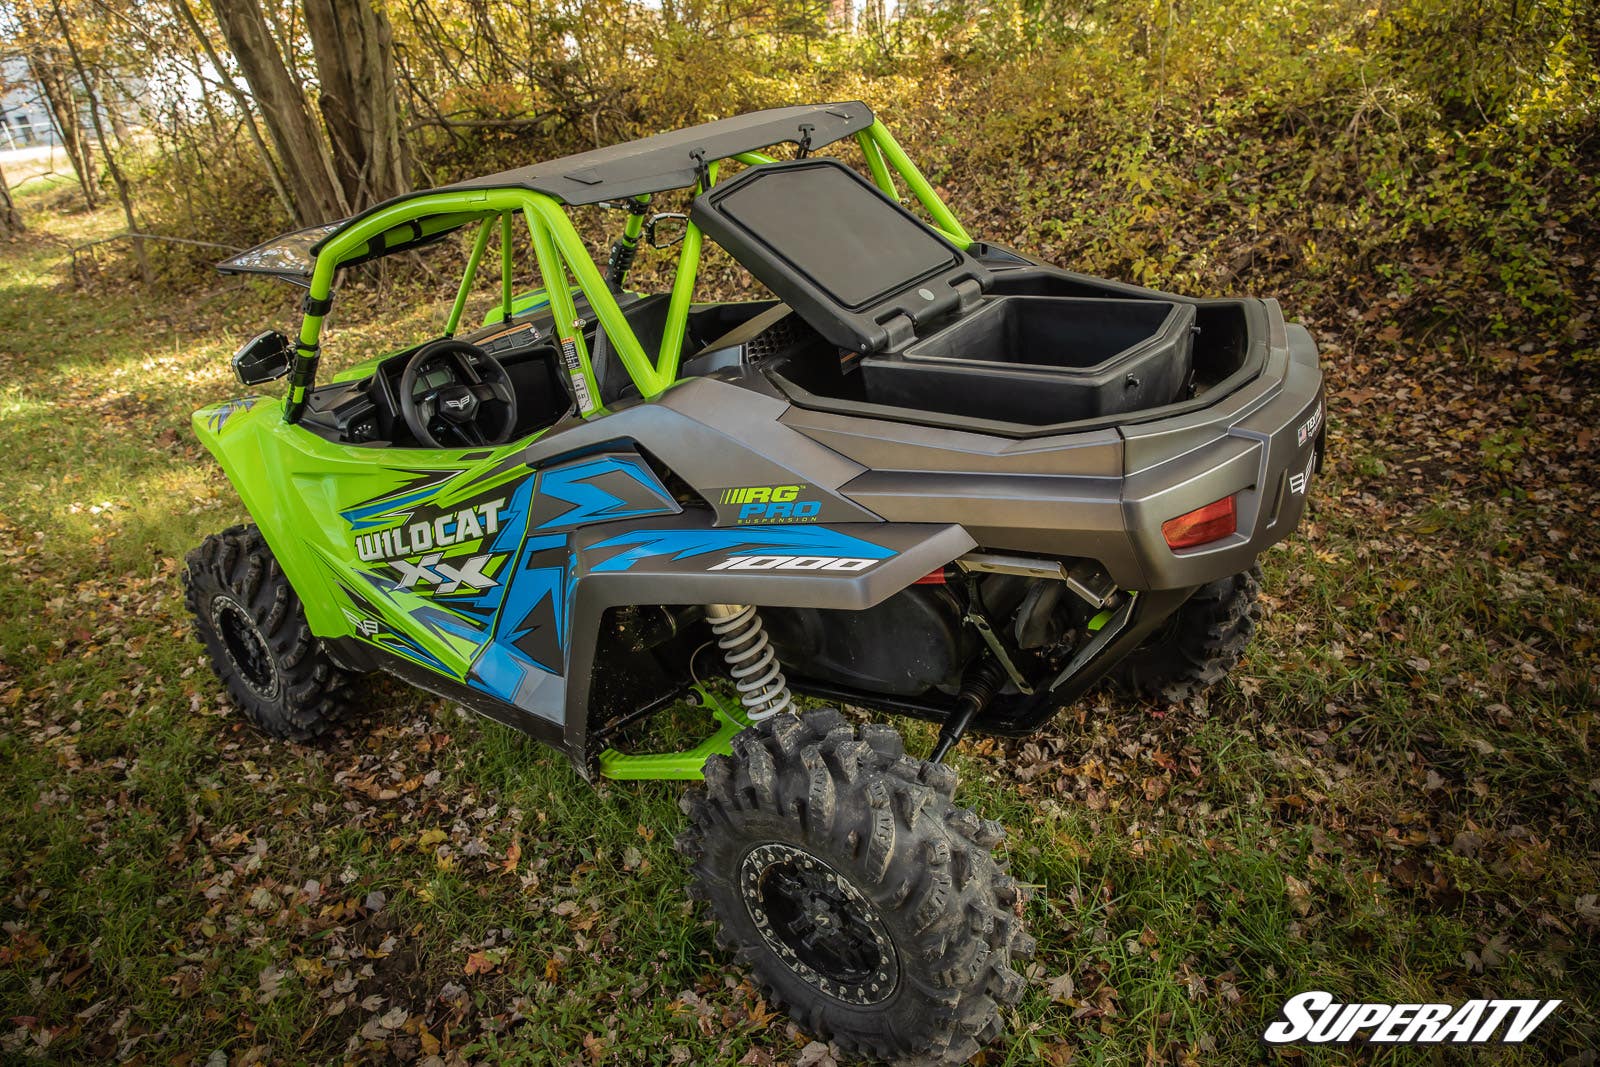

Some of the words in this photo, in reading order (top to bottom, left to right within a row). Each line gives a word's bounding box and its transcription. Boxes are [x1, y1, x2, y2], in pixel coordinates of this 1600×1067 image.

[739, 501, 822, 518] PRO
[737, 517, 817, 525] SUSPENSION
[356, 498, 506, 562] WILDCAT
[706, 557, 880, 571] 1000
[390, 552, 500, 594] XX
